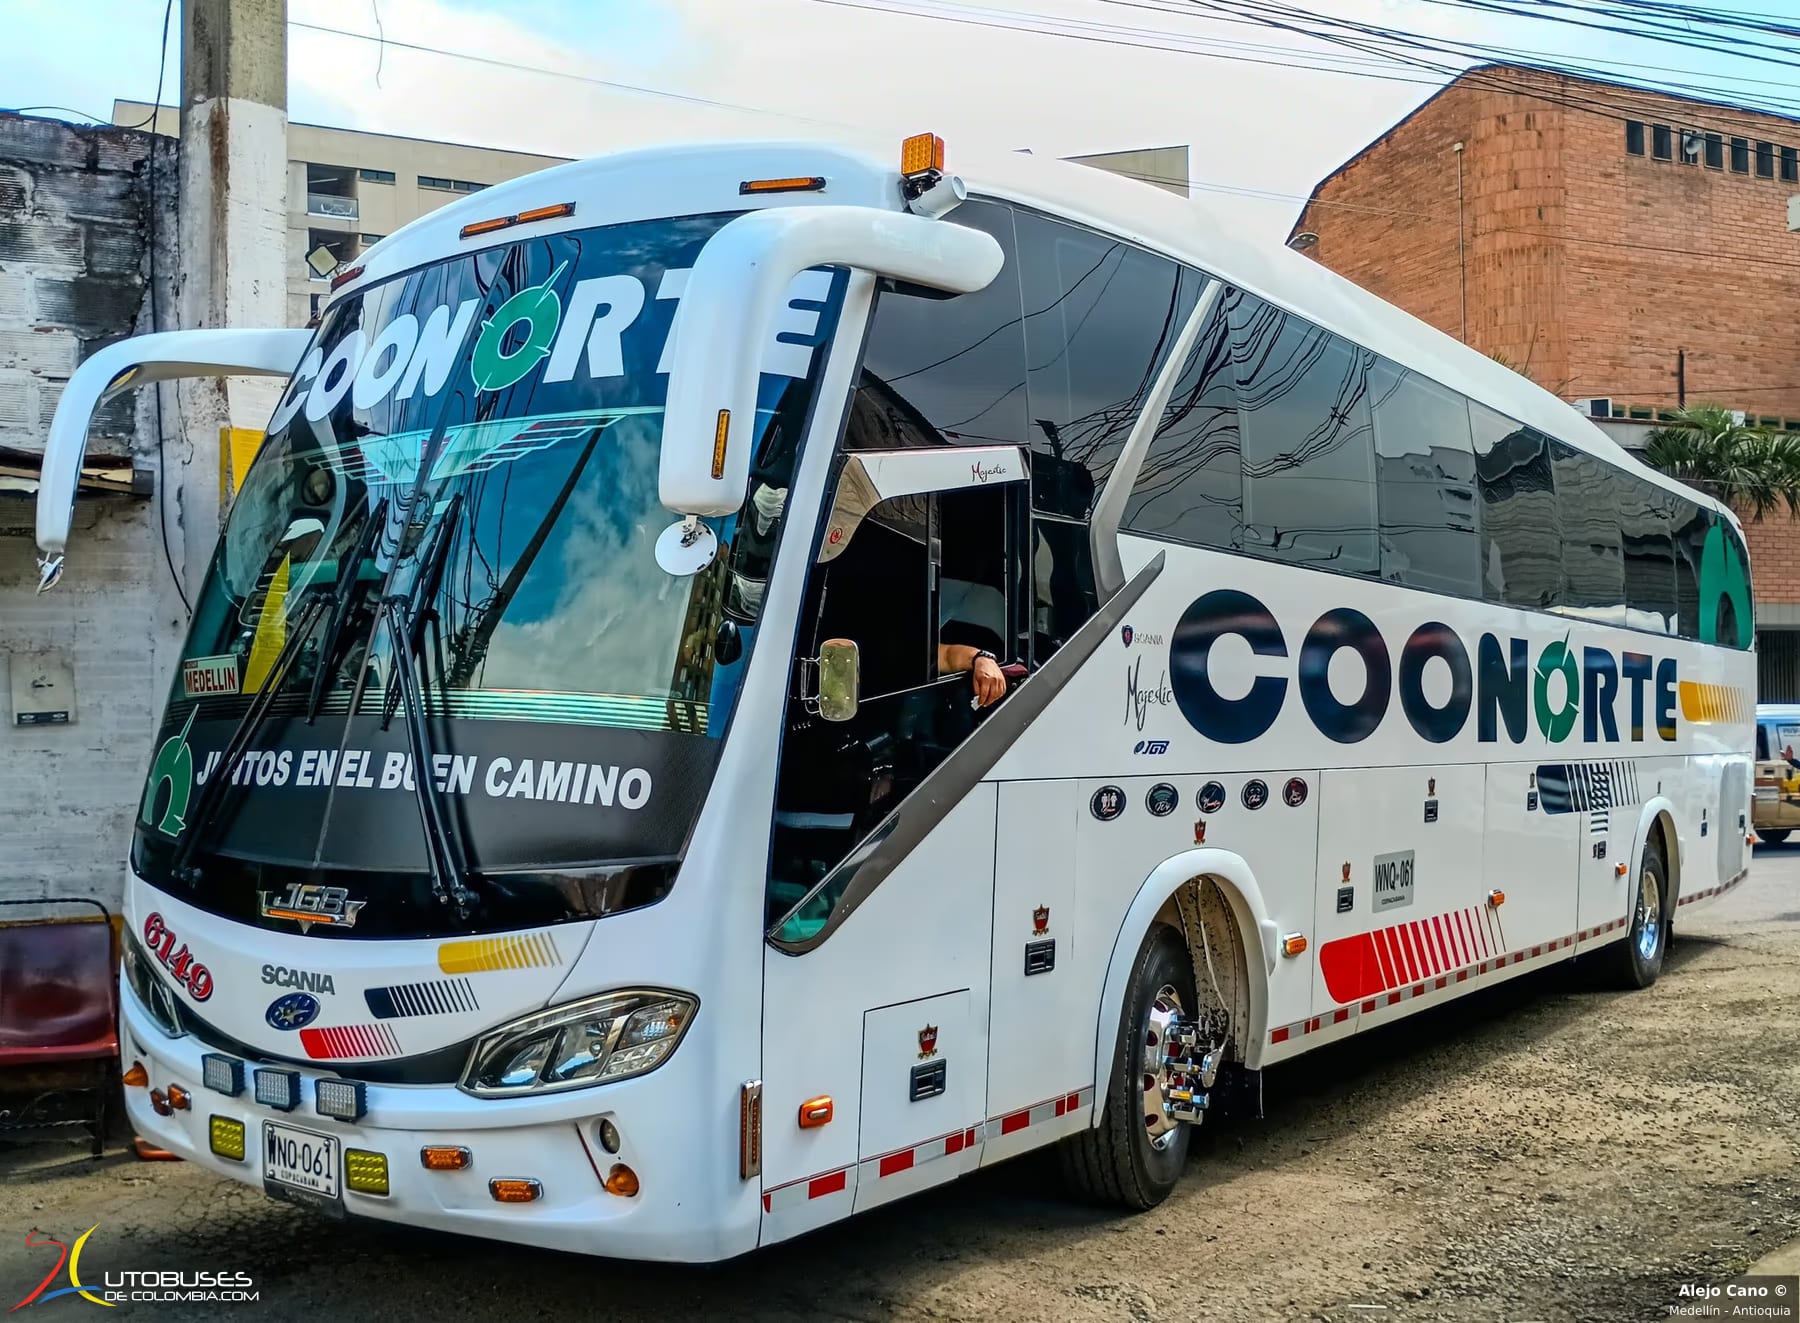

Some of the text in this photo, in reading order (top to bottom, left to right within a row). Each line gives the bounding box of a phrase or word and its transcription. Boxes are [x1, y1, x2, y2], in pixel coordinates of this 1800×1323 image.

[1134, 633, 1163, 645] SCANIA
[185, 667, 236, 692] MEDELLIN
[1169, 589, 1678, 745] COONORTE
[1124, 654, 1173, 732] Majestic
[485, 757, 652, 810] CAMINO
[272, 884, 349, 913] JGB
[144, 912, 214, 1002] 6149
[261, 964, 335, 995] SCANIA
